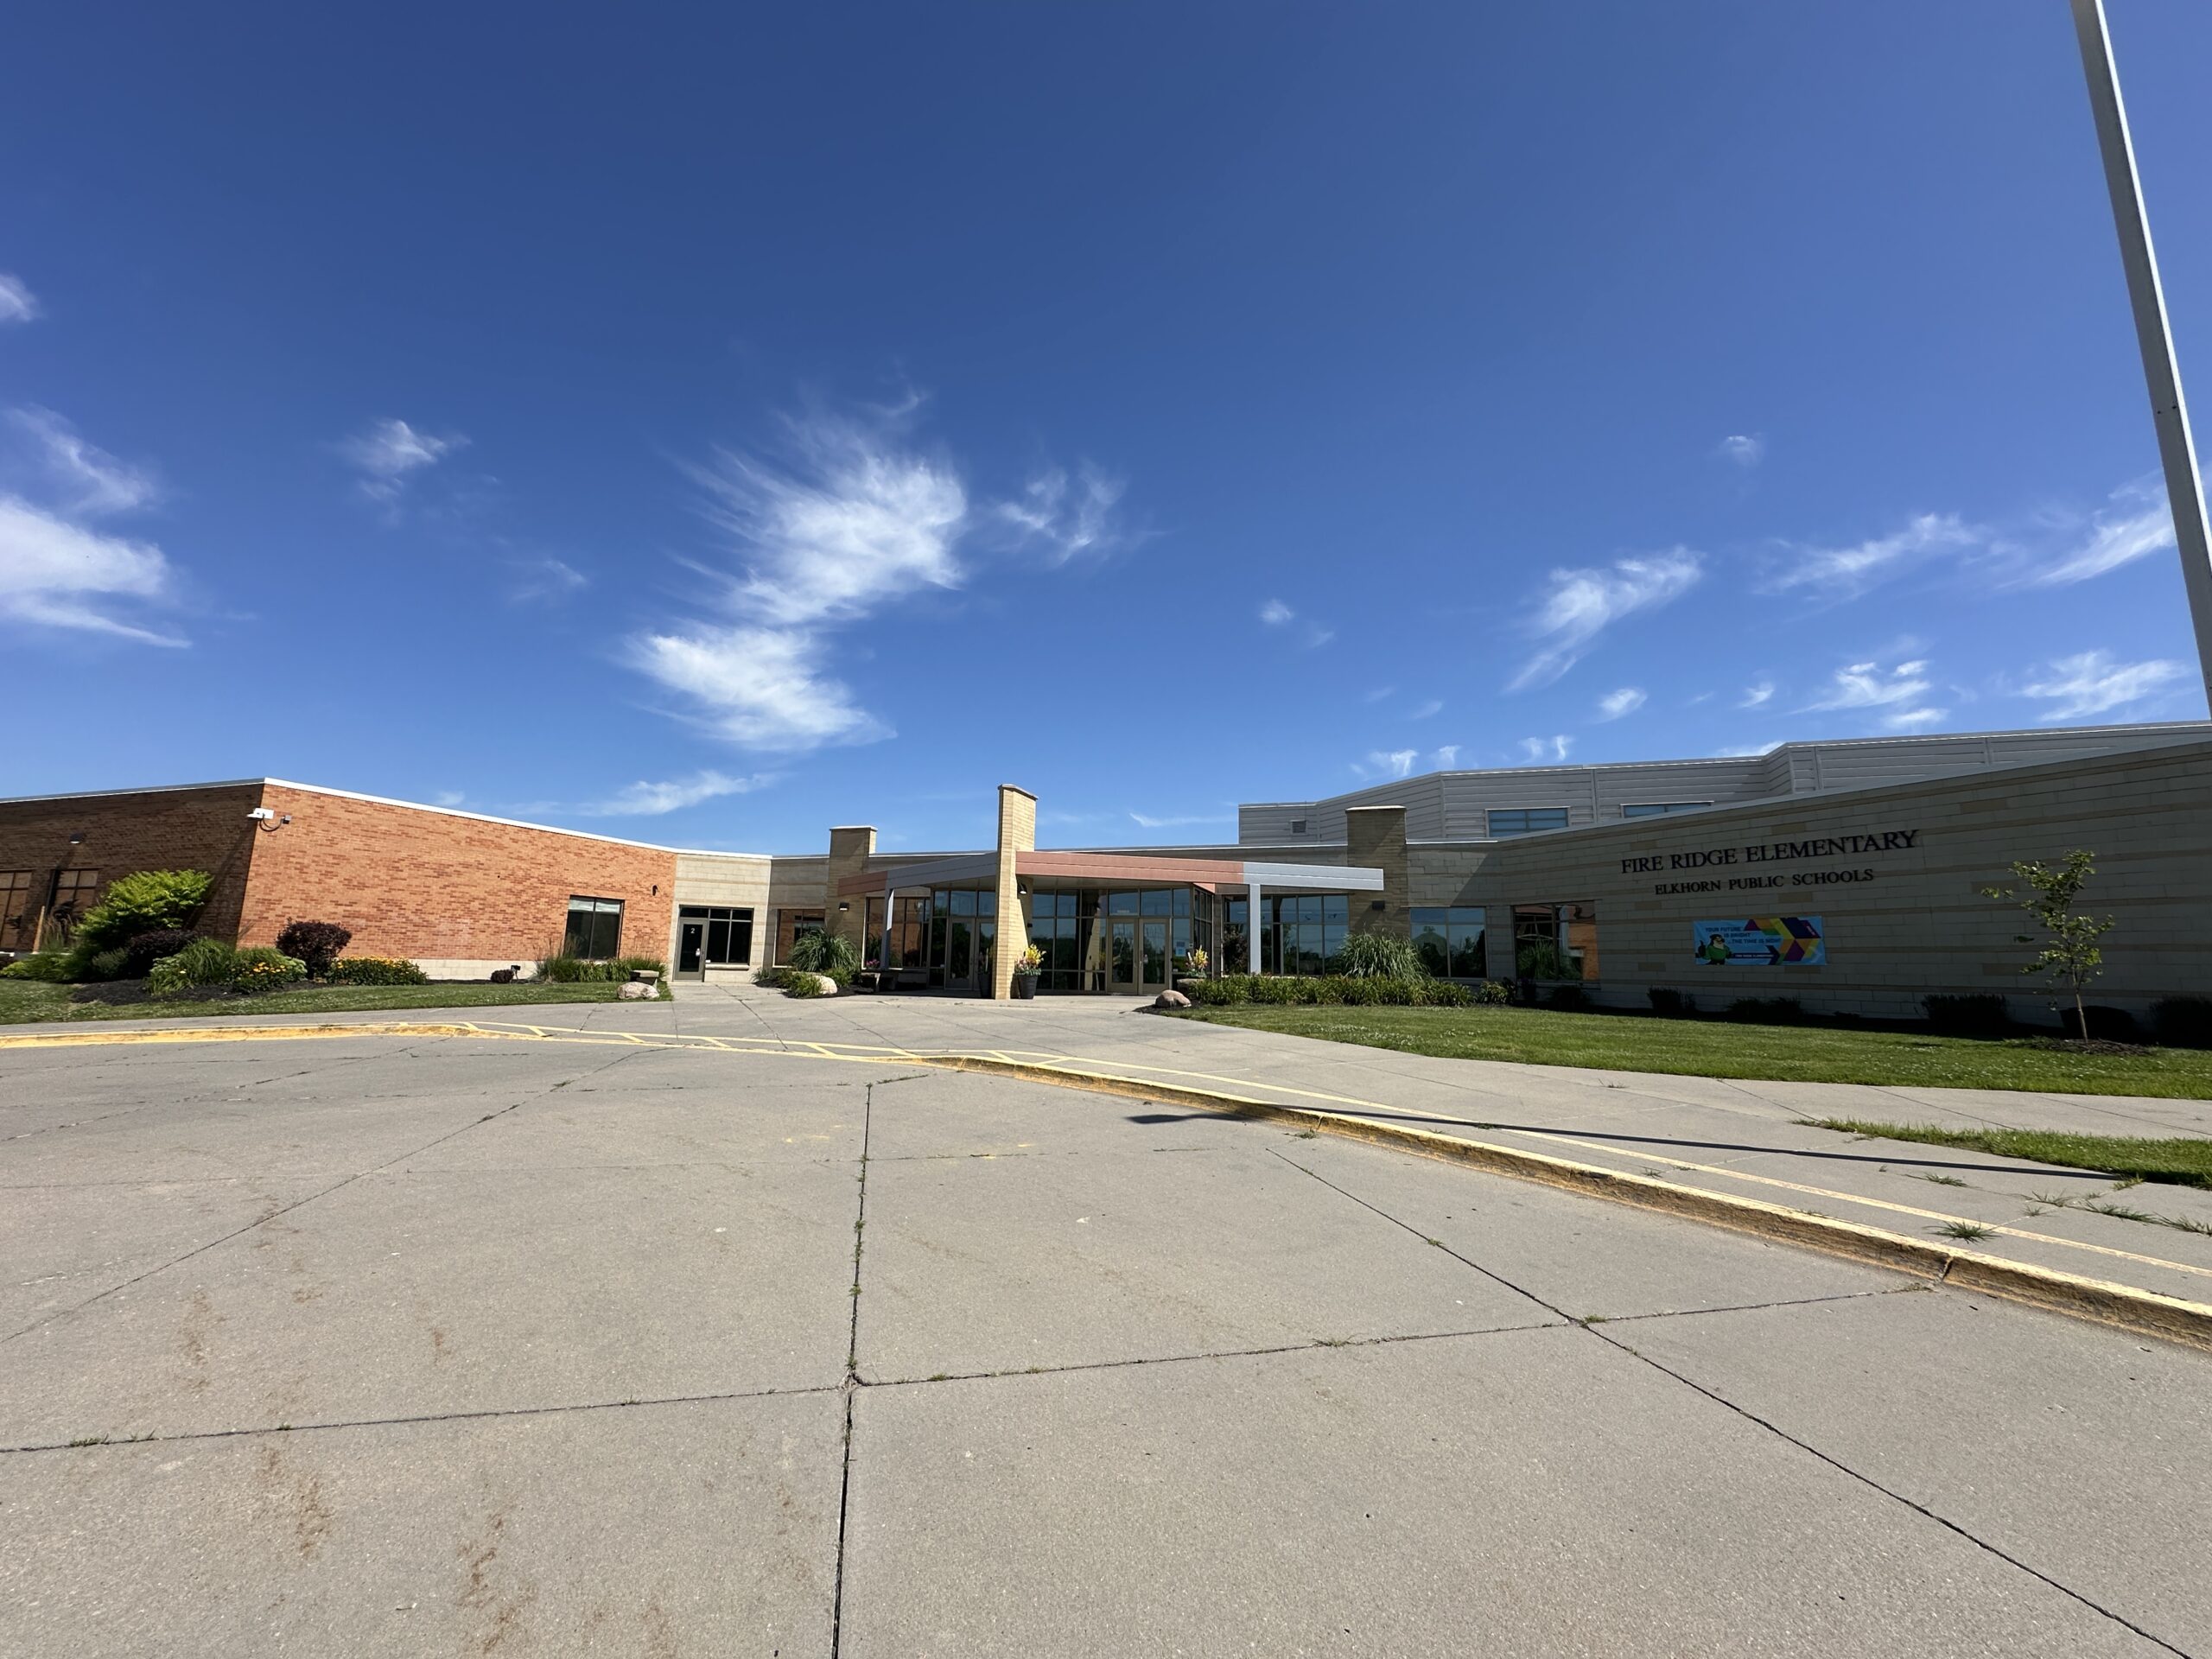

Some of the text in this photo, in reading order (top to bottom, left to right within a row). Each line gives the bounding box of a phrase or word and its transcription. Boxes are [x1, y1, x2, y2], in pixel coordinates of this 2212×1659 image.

[1621, 829, 1920, 874] FIRE RIDGE ELEMENTARY
[1655, 868, 1874, 895] ELKHORN PUBLIC SCHOOLS
